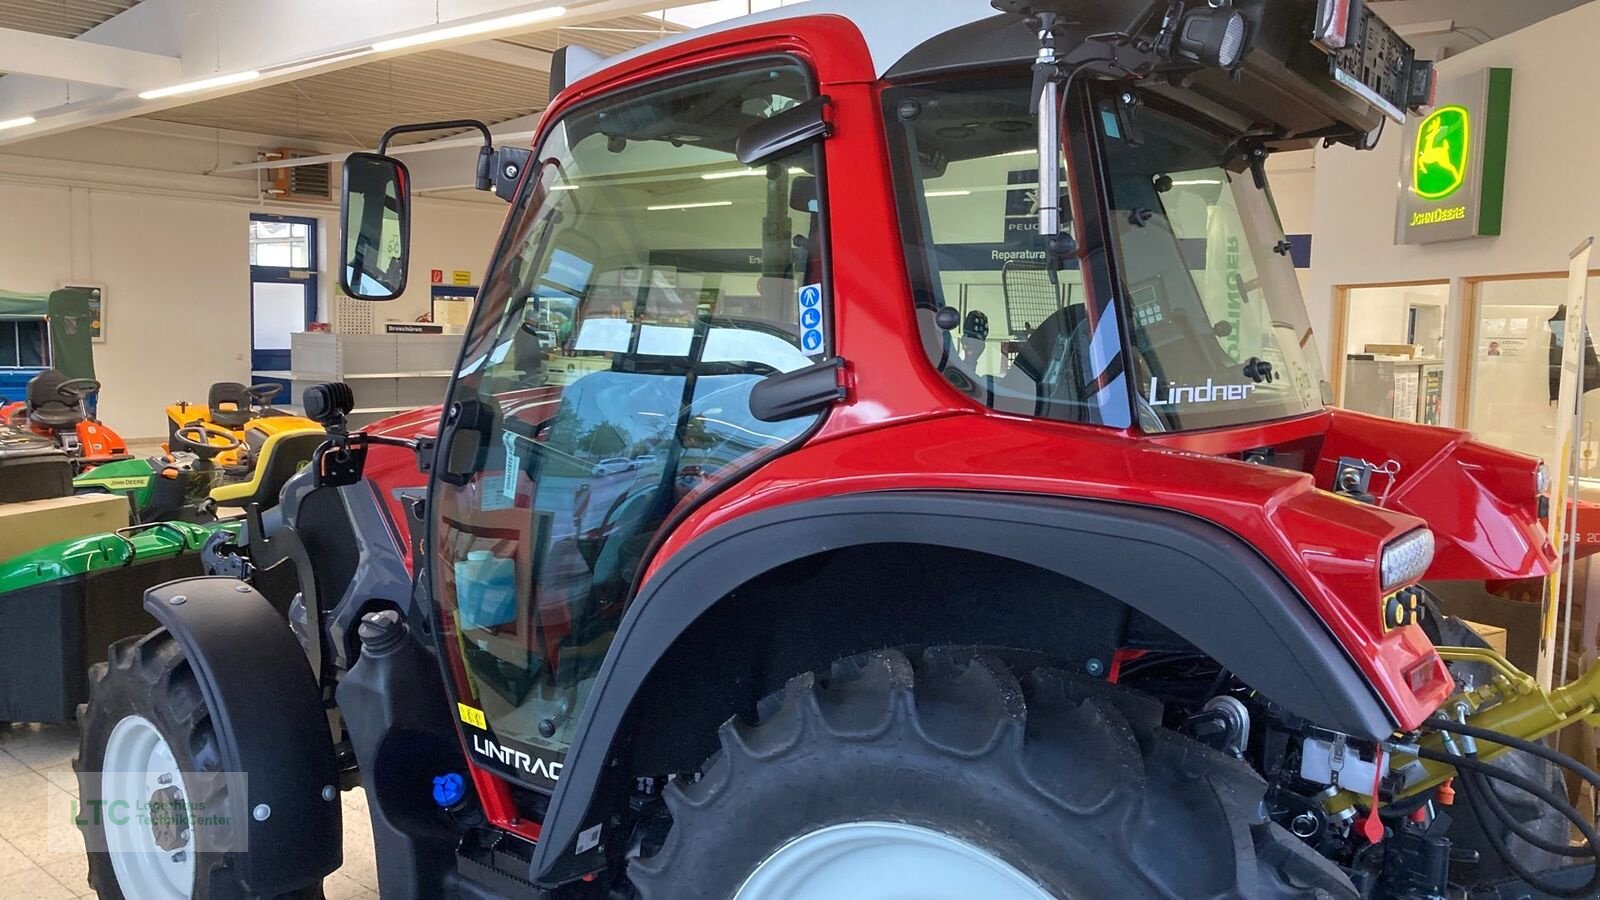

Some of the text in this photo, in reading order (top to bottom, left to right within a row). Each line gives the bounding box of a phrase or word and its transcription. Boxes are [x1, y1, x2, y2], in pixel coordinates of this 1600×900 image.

[991, 250, 1046, 261] Reparatura
[1150, 377, 1256, 405] Lindner
[473, 734, 564, 781] LINTRAC
